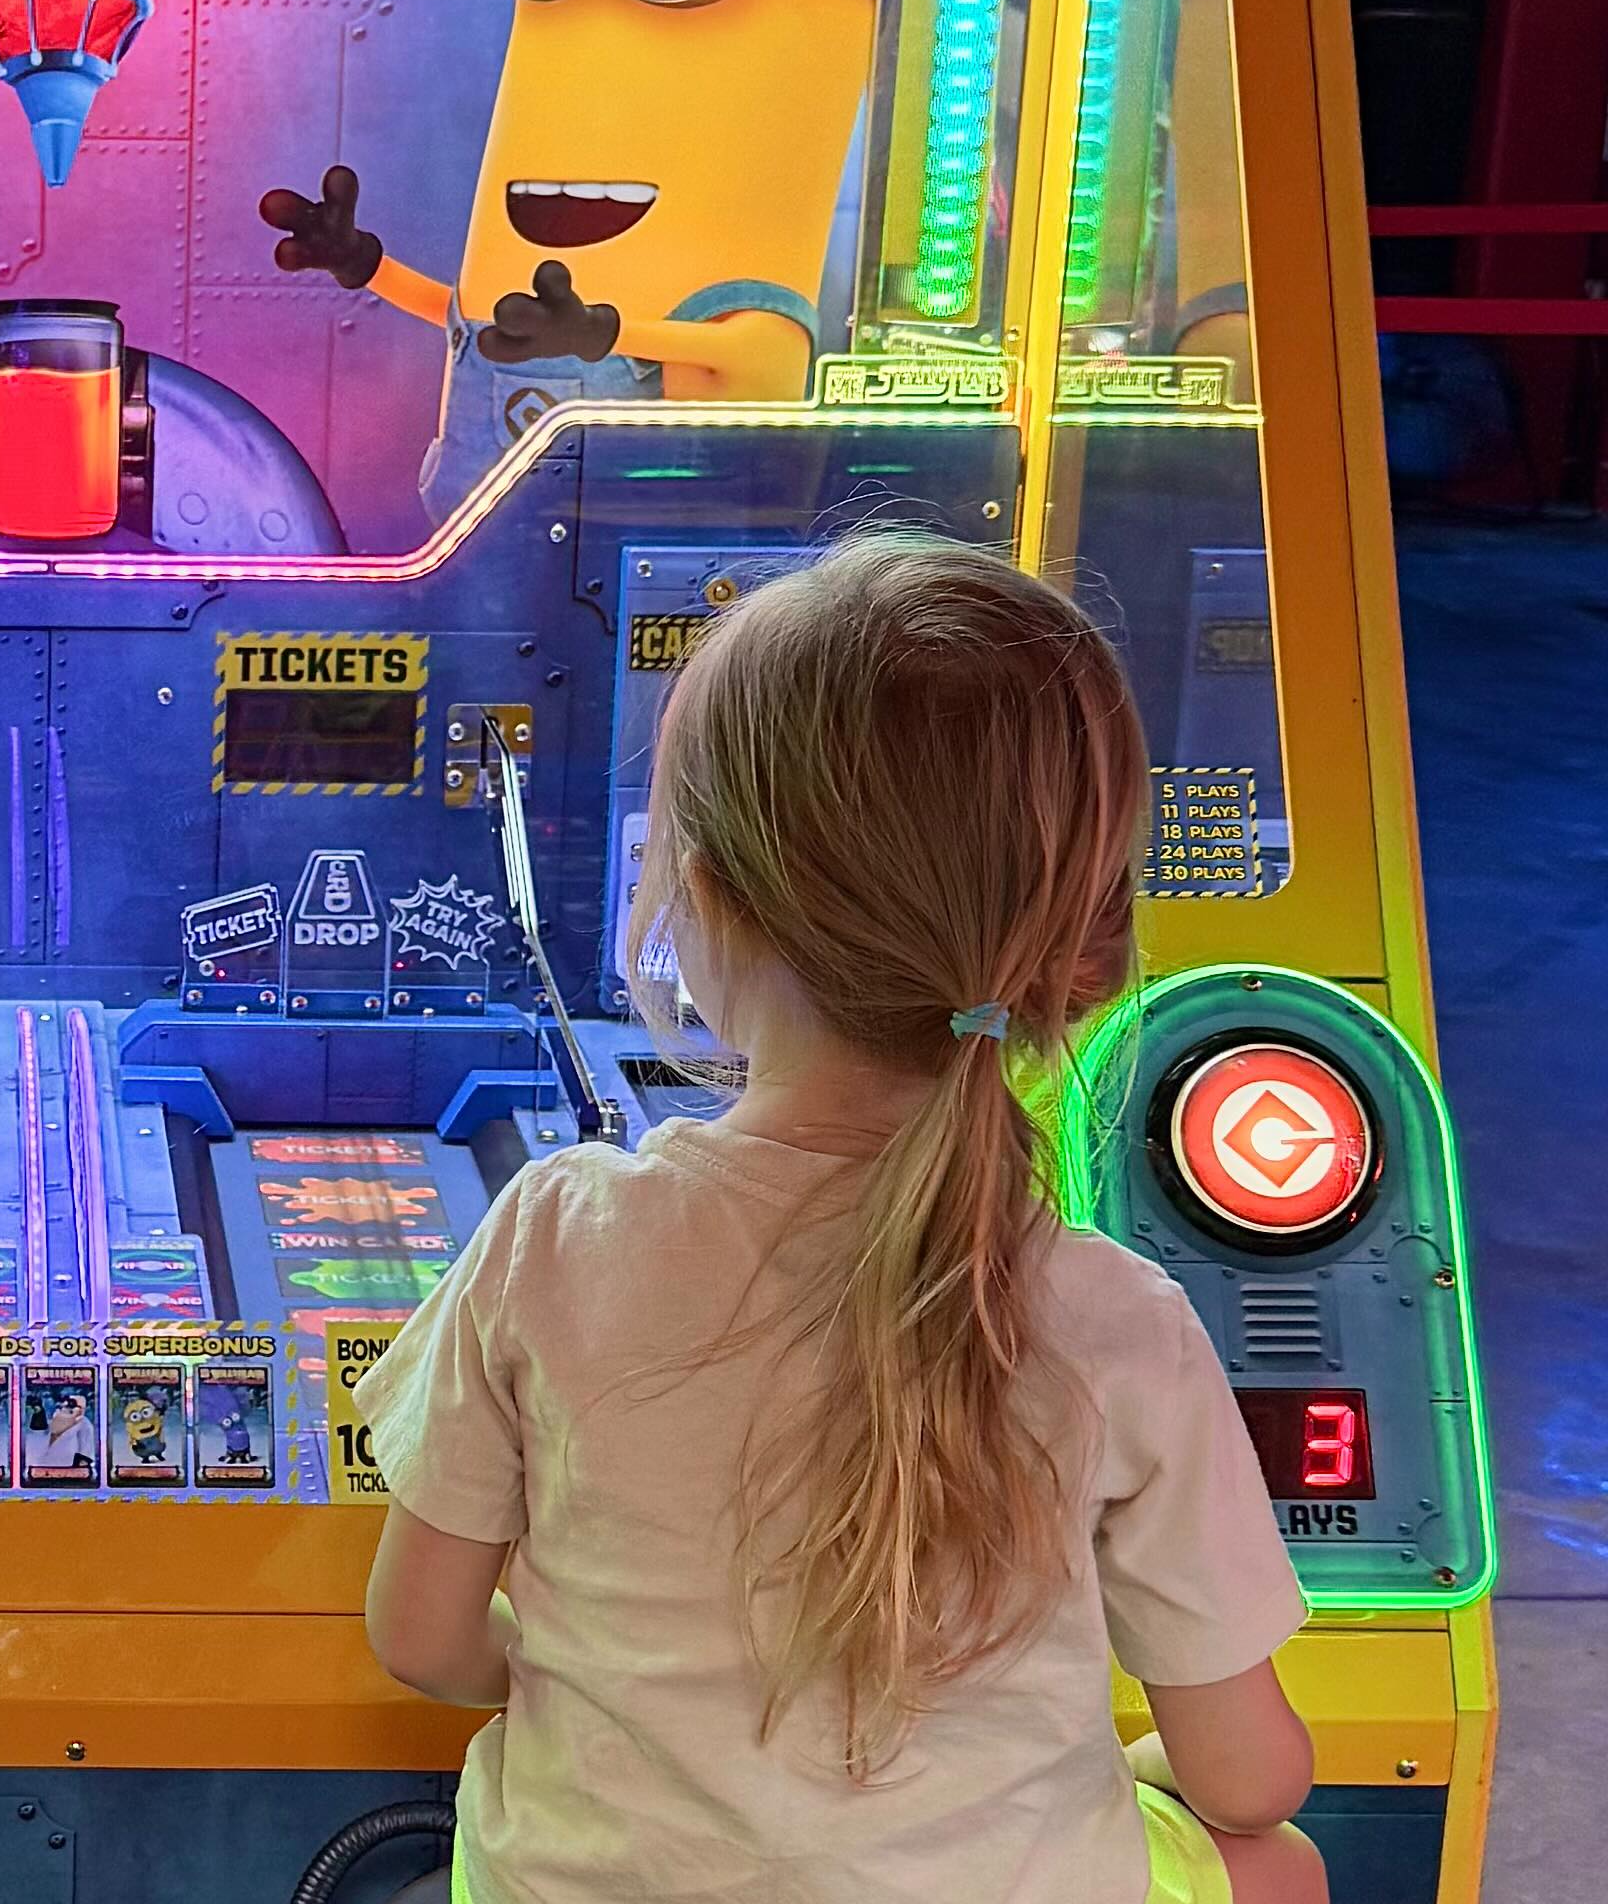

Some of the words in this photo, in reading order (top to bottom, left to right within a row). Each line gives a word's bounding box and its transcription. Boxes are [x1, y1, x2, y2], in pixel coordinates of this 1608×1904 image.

[234, 647, 408, 683] TICKETS
[1162, 784, 1176, 799] 5
[1186, 784, 1240, 799] PLAYS
[1161, 804, 1179, 819] 11
[1187, 805, 1242, 819] PLAYS
[1161, 824, 1183, 840] 18
[1189, 825, 1243, 840] PLAYS
[1159, 845, 1187, 861] 24
[1191, 846, 1245, 860] PLAYS
[1160, 865, 1189, 881] 30
[1192, 867, 1246, 881] PLAYS
[426, 900, 469, 927] TRY
[194, 908, 267, 946] TICKET
[294, 923, 380, 946] DROP
[405, 913, 480, 950] AGAIN
[283, 1144, 396, 1155] TICKETS
[287, 1236, 349, 1247] WIN
[357, 1236, 442, 1249] CARD
[42, 1335, 98, 1356] FOR
[104, 1335, 277, 1357] SUPERBONUS
[1304, 1405, 1355, 1486] 3
[1280, 1503, 1359, 1536] AYS
